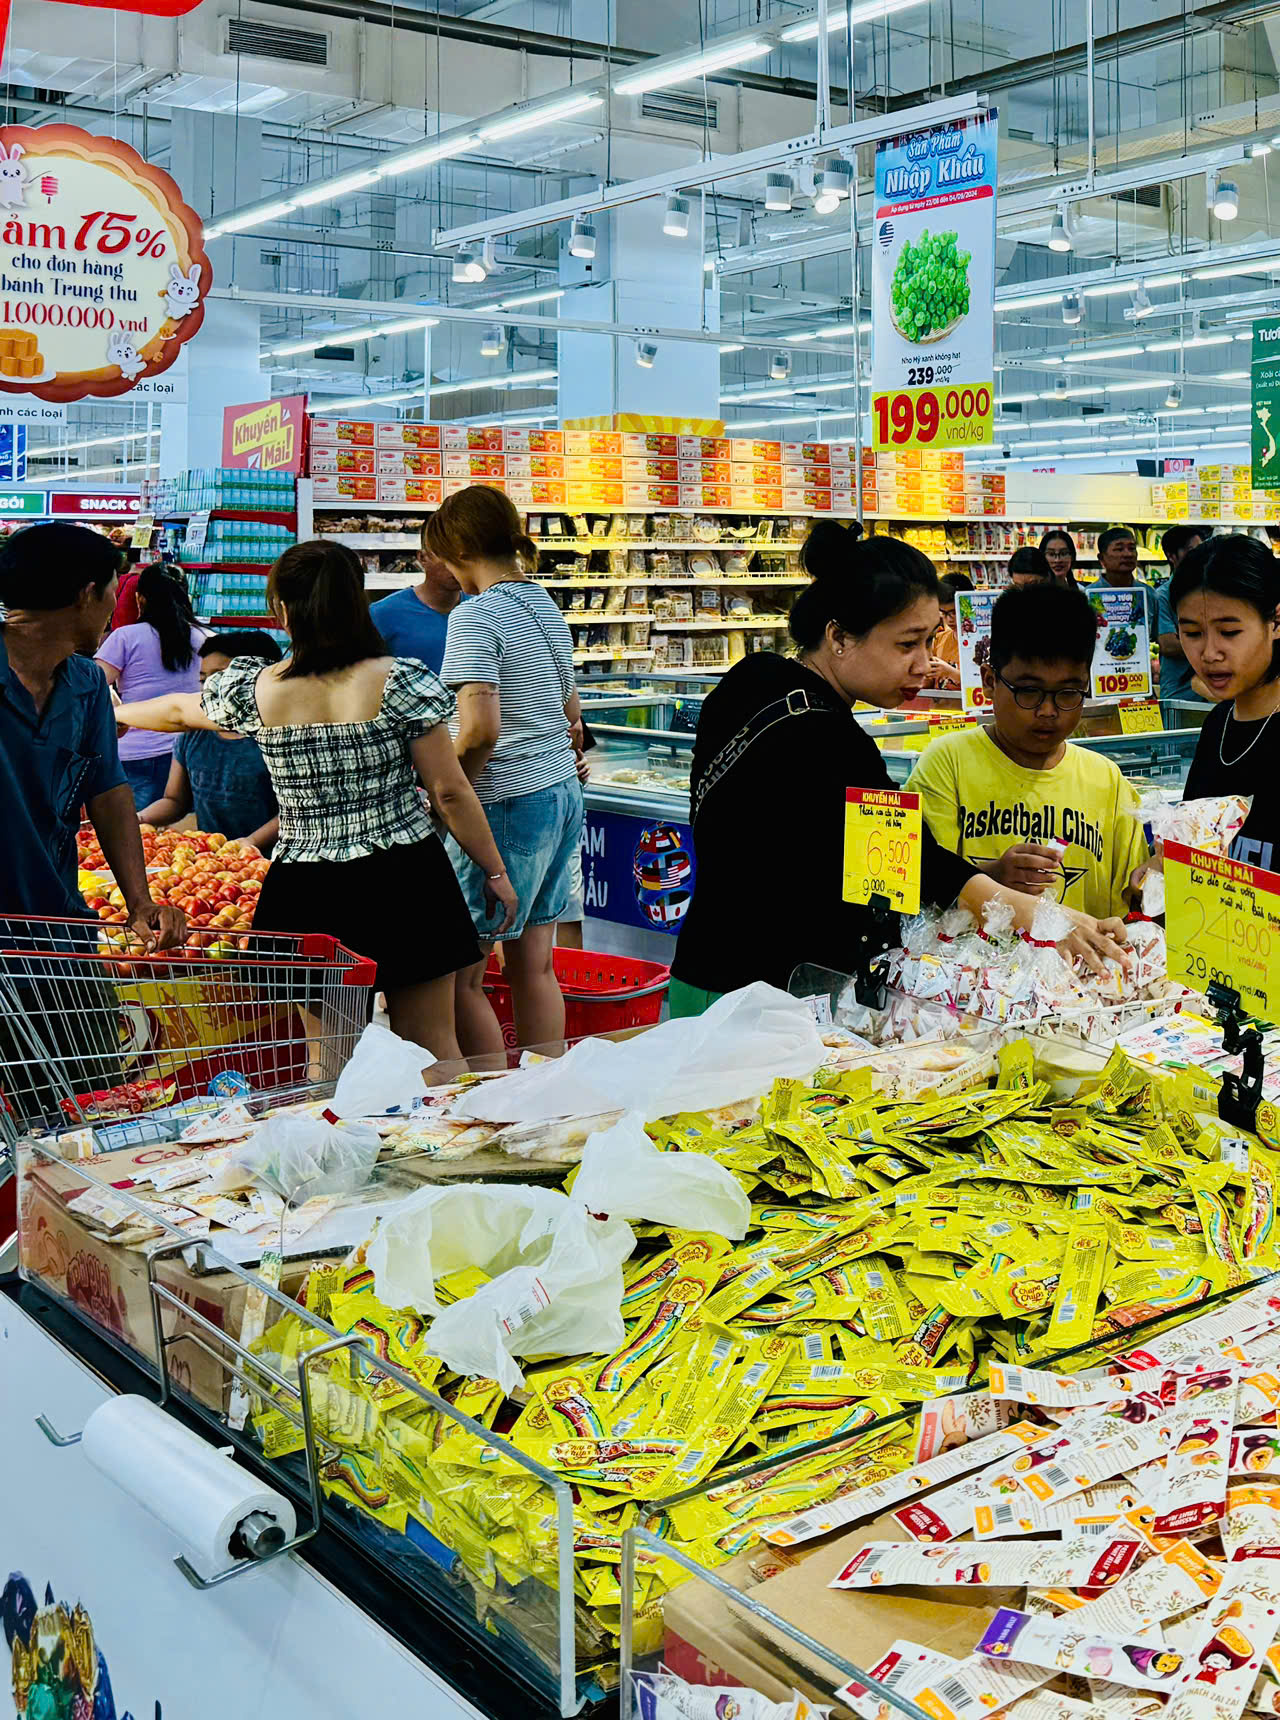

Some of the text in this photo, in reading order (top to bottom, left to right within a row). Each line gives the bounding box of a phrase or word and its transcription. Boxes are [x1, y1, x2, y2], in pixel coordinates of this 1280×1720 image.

[886, 145, 985, 197] Nhập Khẩu
[74, 211, 167, 259] 15%
[12, 254, 124, 281] cho đơn hàng
[1, 274, 138, 303] bánh Trung thu
[3, 301, 148, 333] 1.000.000 vnd
[1258, 323, 1280, 342] Tươi
[152, 381, 174, 395] loại
[16, 405, 64, 419] các loại
[873, 387, 991, 445] 199.000
[233, 409, 279, 447] Khuyến
[946, 420, 984, 441] vnd/kg
[79, 499, 127, 512] SNACK
[1190, 850, 1233, 878] KHUYẾN
